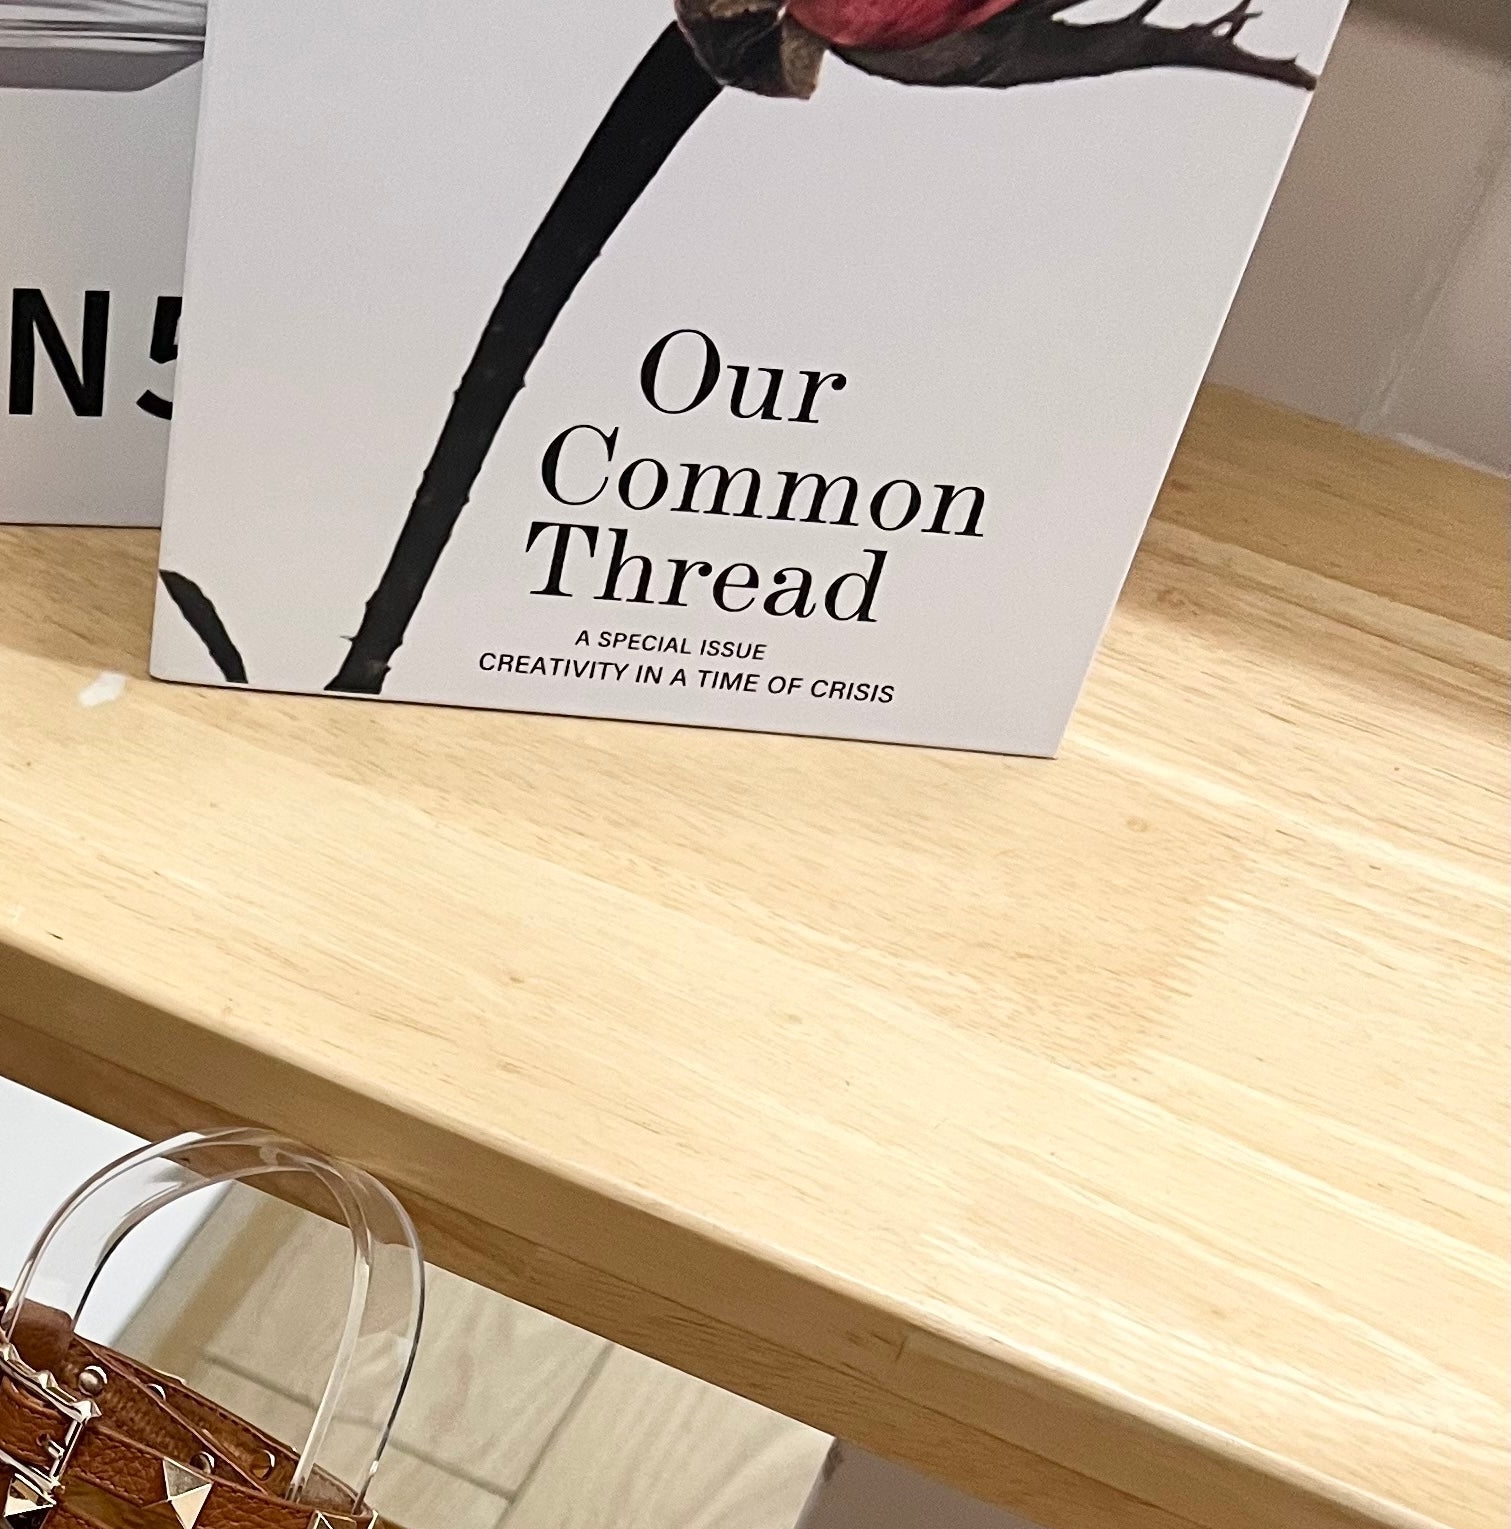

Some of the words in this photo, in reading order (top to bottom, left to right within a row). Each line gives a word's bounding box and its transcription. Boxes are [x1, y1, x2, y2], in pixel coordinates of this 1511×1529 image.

[639, 328, 848, 425] Our
[540, 424, 987, 538] Common
[524, 520, 889, 623] Thread
[478, 652, 630, 681] CREATIVITY
[635, 664, 664, 685] IN
[669, 668, 687, 688] A
[697, 669, 762, 693] TIME
[766, 675, 805, 696] OF
[809, 679, 896, 704] CRISIS
[574, 630, 591, 647] A
[597, 631, 693, 656] SPECIAL
[699, 639, 768, 661] ISSUE
